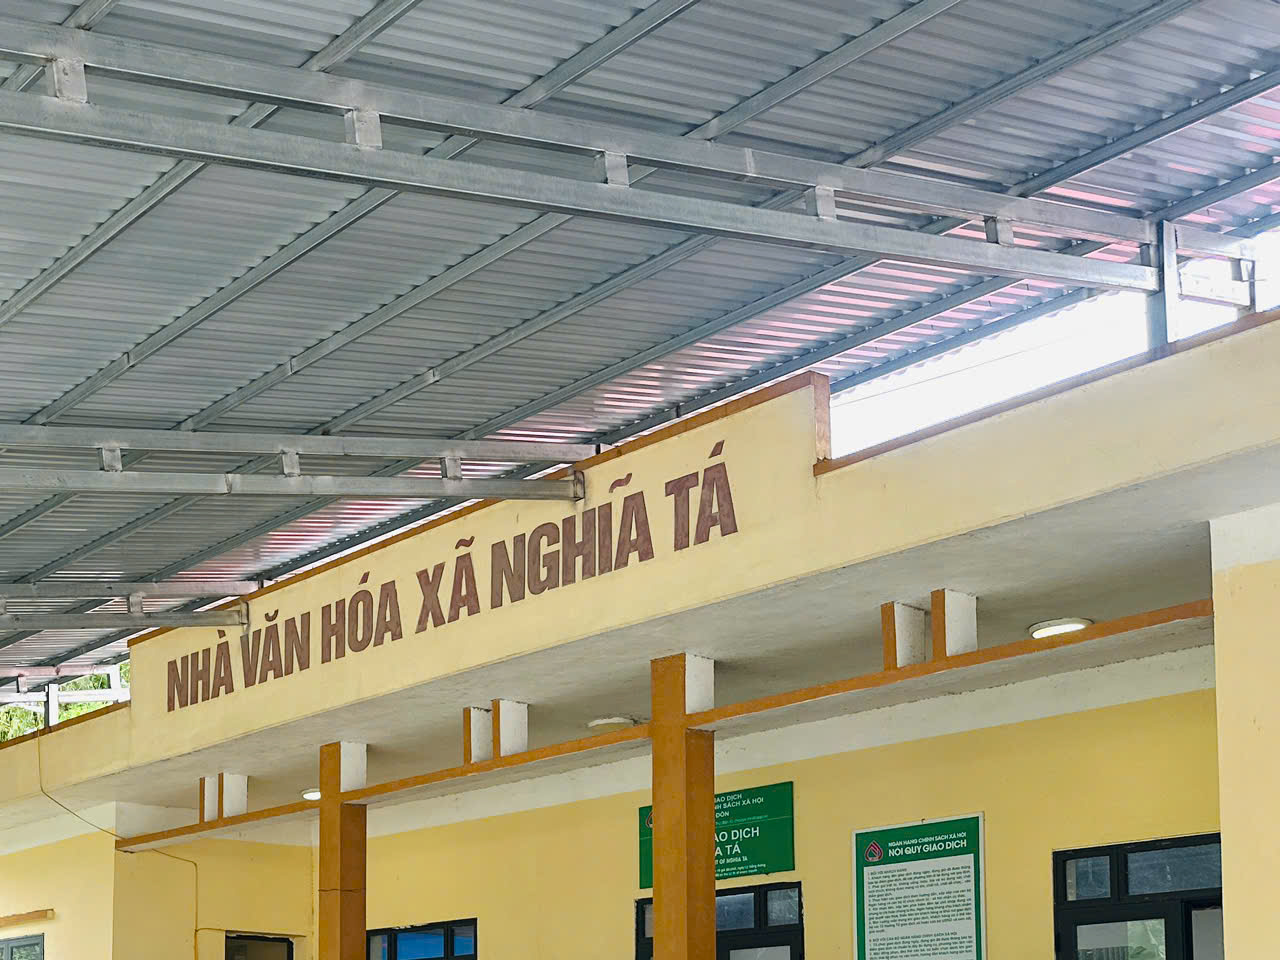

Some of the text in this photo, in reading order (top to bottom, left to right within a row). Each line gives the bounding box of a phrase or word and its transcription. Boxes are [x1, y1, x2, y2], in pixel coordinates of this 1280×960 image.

[167, 629, 234, 713] NHÀ
[241, 609, 311, 690] VĂN
[320, 571, 403, 665] HÓA
[415, 535, 480, 634] XÃ
[665, 440, 738, 552] TÁ
[731, 827, 759, 841] DỊCH
[725, 841, 741, 855] TÁ
[905, 845, 921, 854] QUY
[922, 842, 945, 853] GIAO
